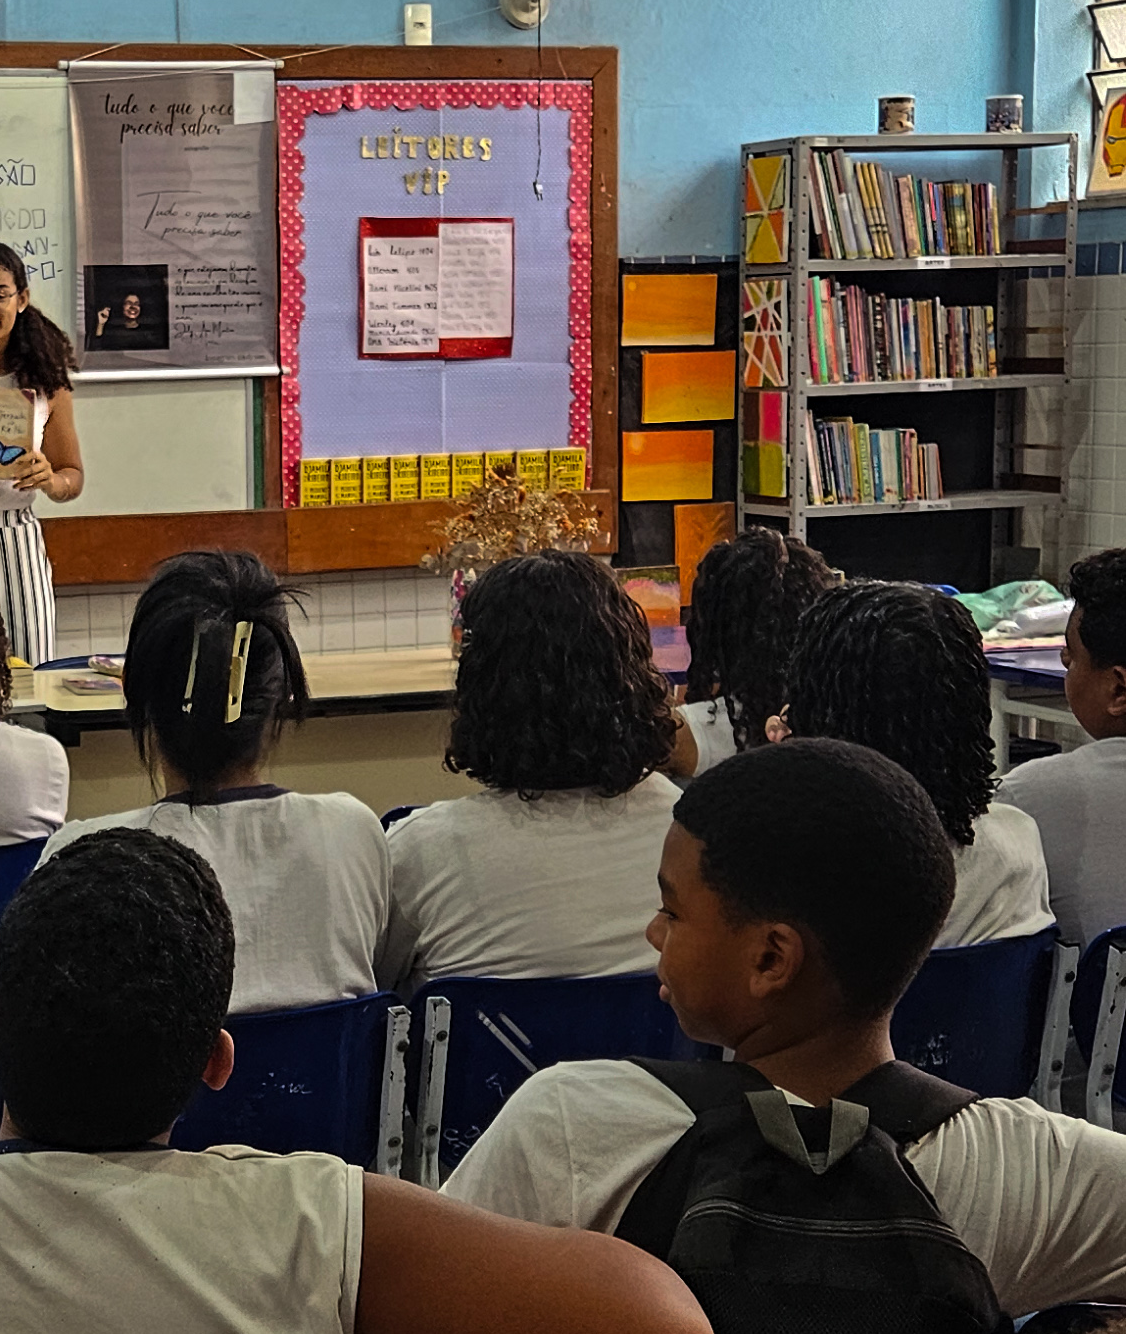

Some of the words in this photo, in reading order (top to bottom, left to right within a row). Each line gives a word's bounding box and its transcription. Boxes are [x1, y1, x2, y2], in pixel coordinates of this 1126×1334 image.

[100, 93, 140, 114] tudo
[149, 104, 159, 115] o
[167, 103, 194, 123] que
[120, 120, 174, 144] precisa
[181, 114, 222, 136] saber
[360, 127, 493, 161] LEITORES
[403, 167, 451, 195] VIP
